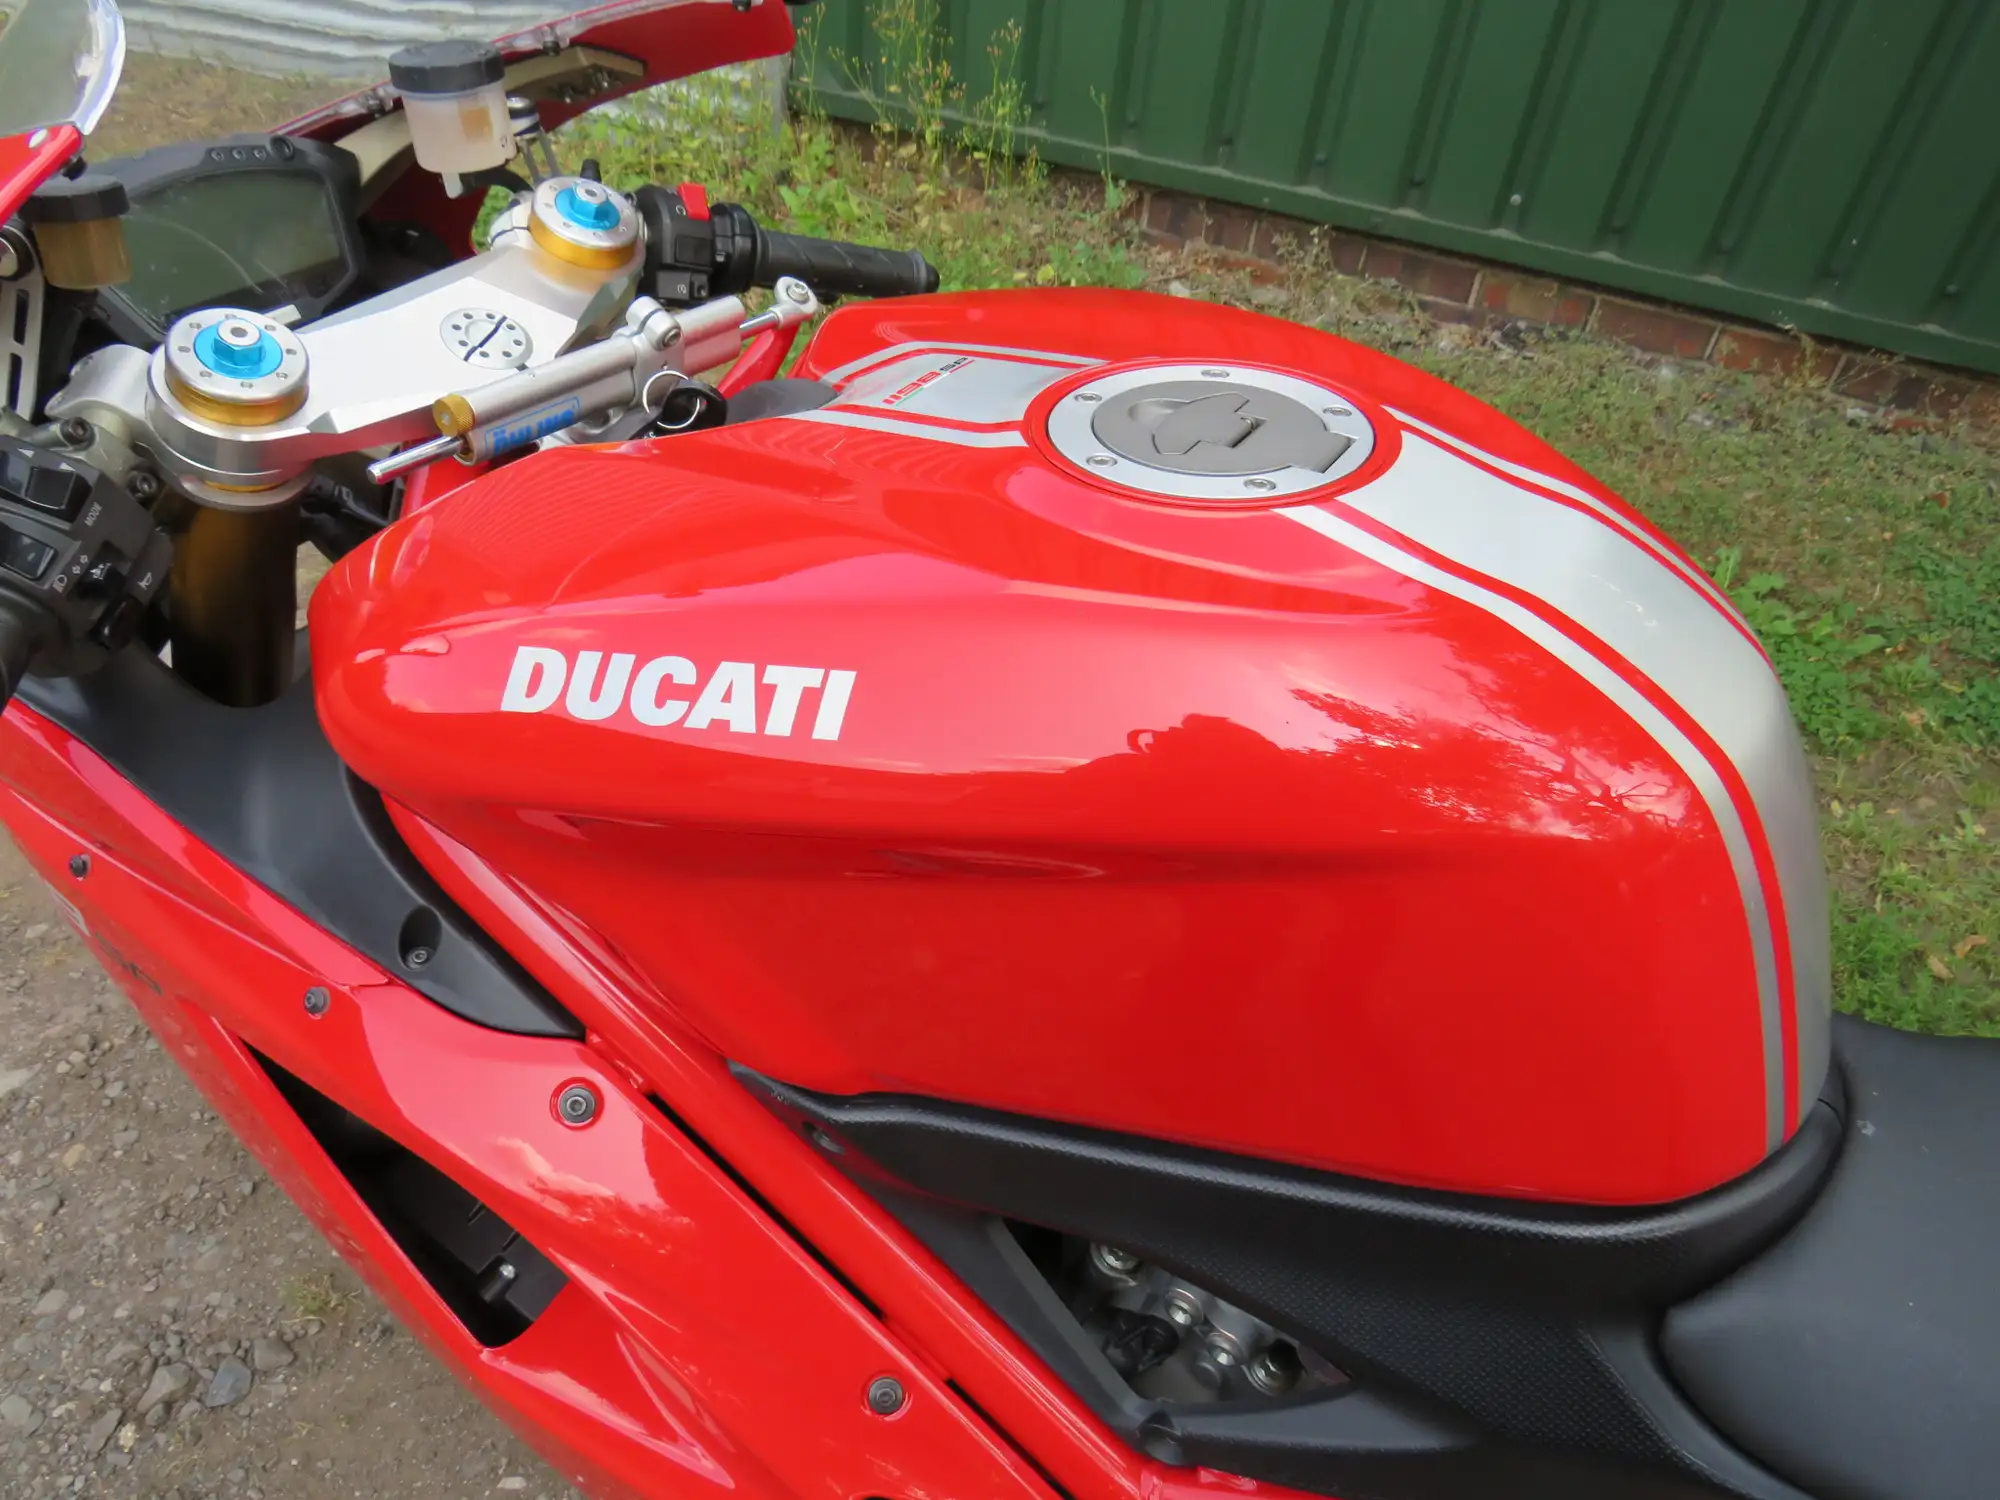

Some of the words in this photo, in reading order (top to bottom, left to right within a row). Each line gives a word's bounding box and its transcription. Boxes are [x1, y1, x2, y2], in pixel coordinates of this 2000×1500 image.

[882, 371, 941, 405] 1198
[940, 357, 968, 371] SP
[84, 502, 102, 527] MODE
[500, 646, 857, 741] DUCATI
